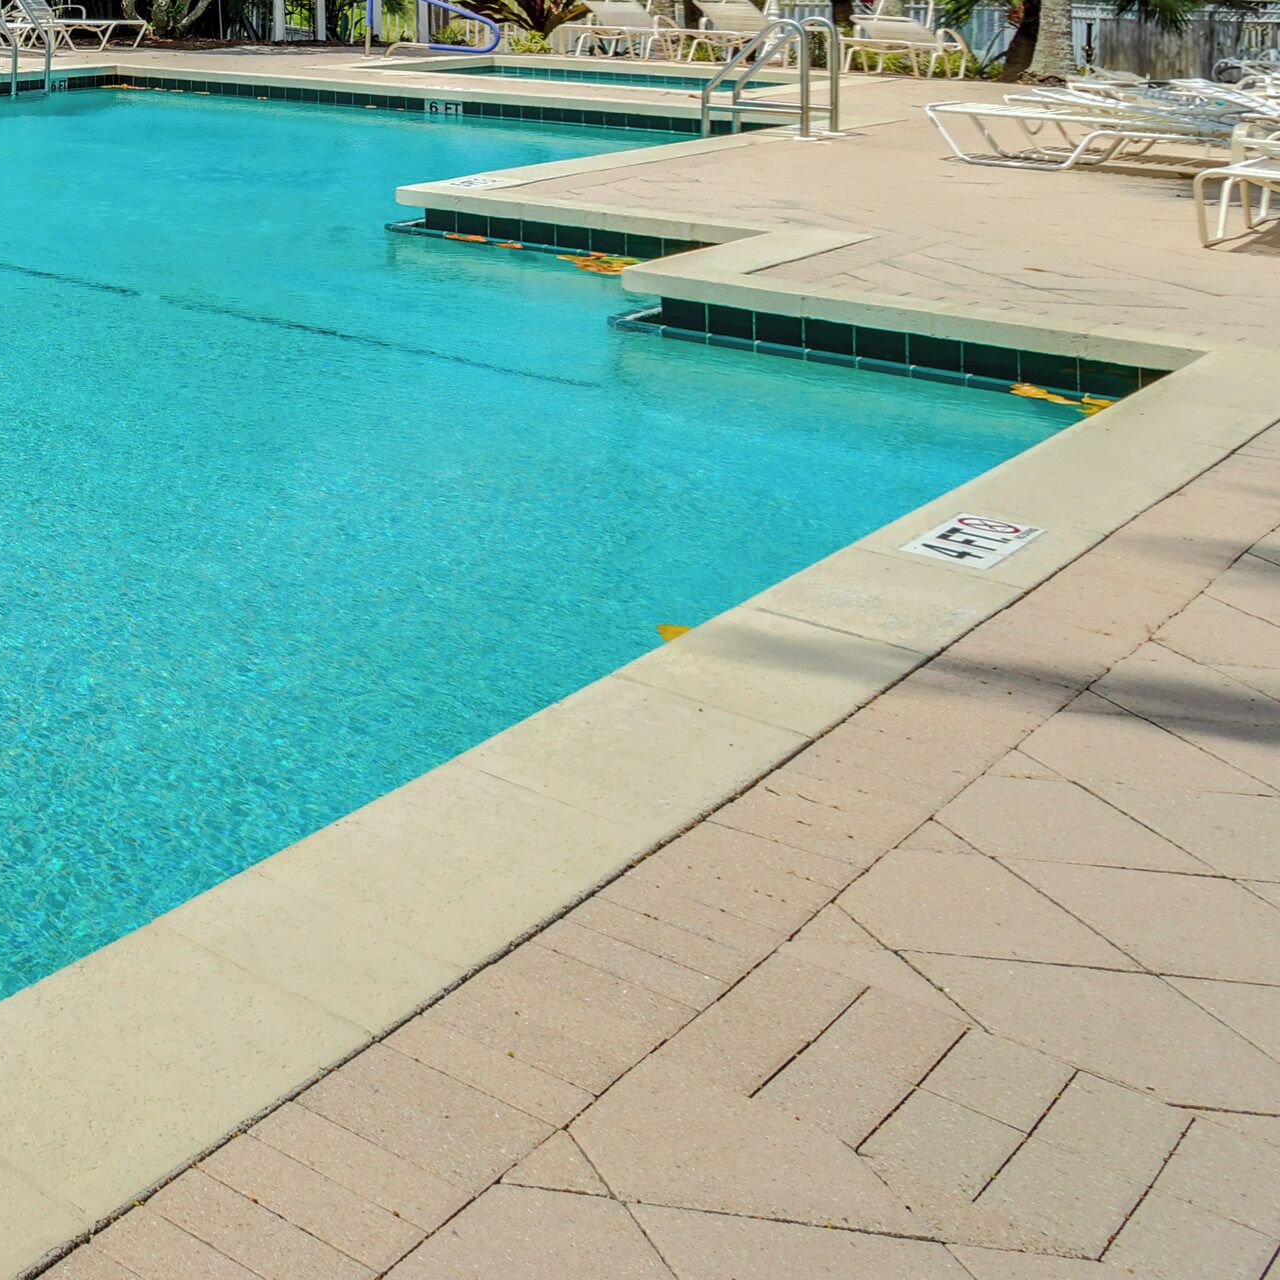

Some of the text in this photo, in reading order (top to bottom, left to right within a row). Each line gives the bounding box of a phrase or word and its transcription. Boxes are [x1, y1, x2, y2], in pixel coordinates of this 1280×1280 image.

[429, 101, 461, 114] 6 FT
[921, 543, 984, 559] 4
